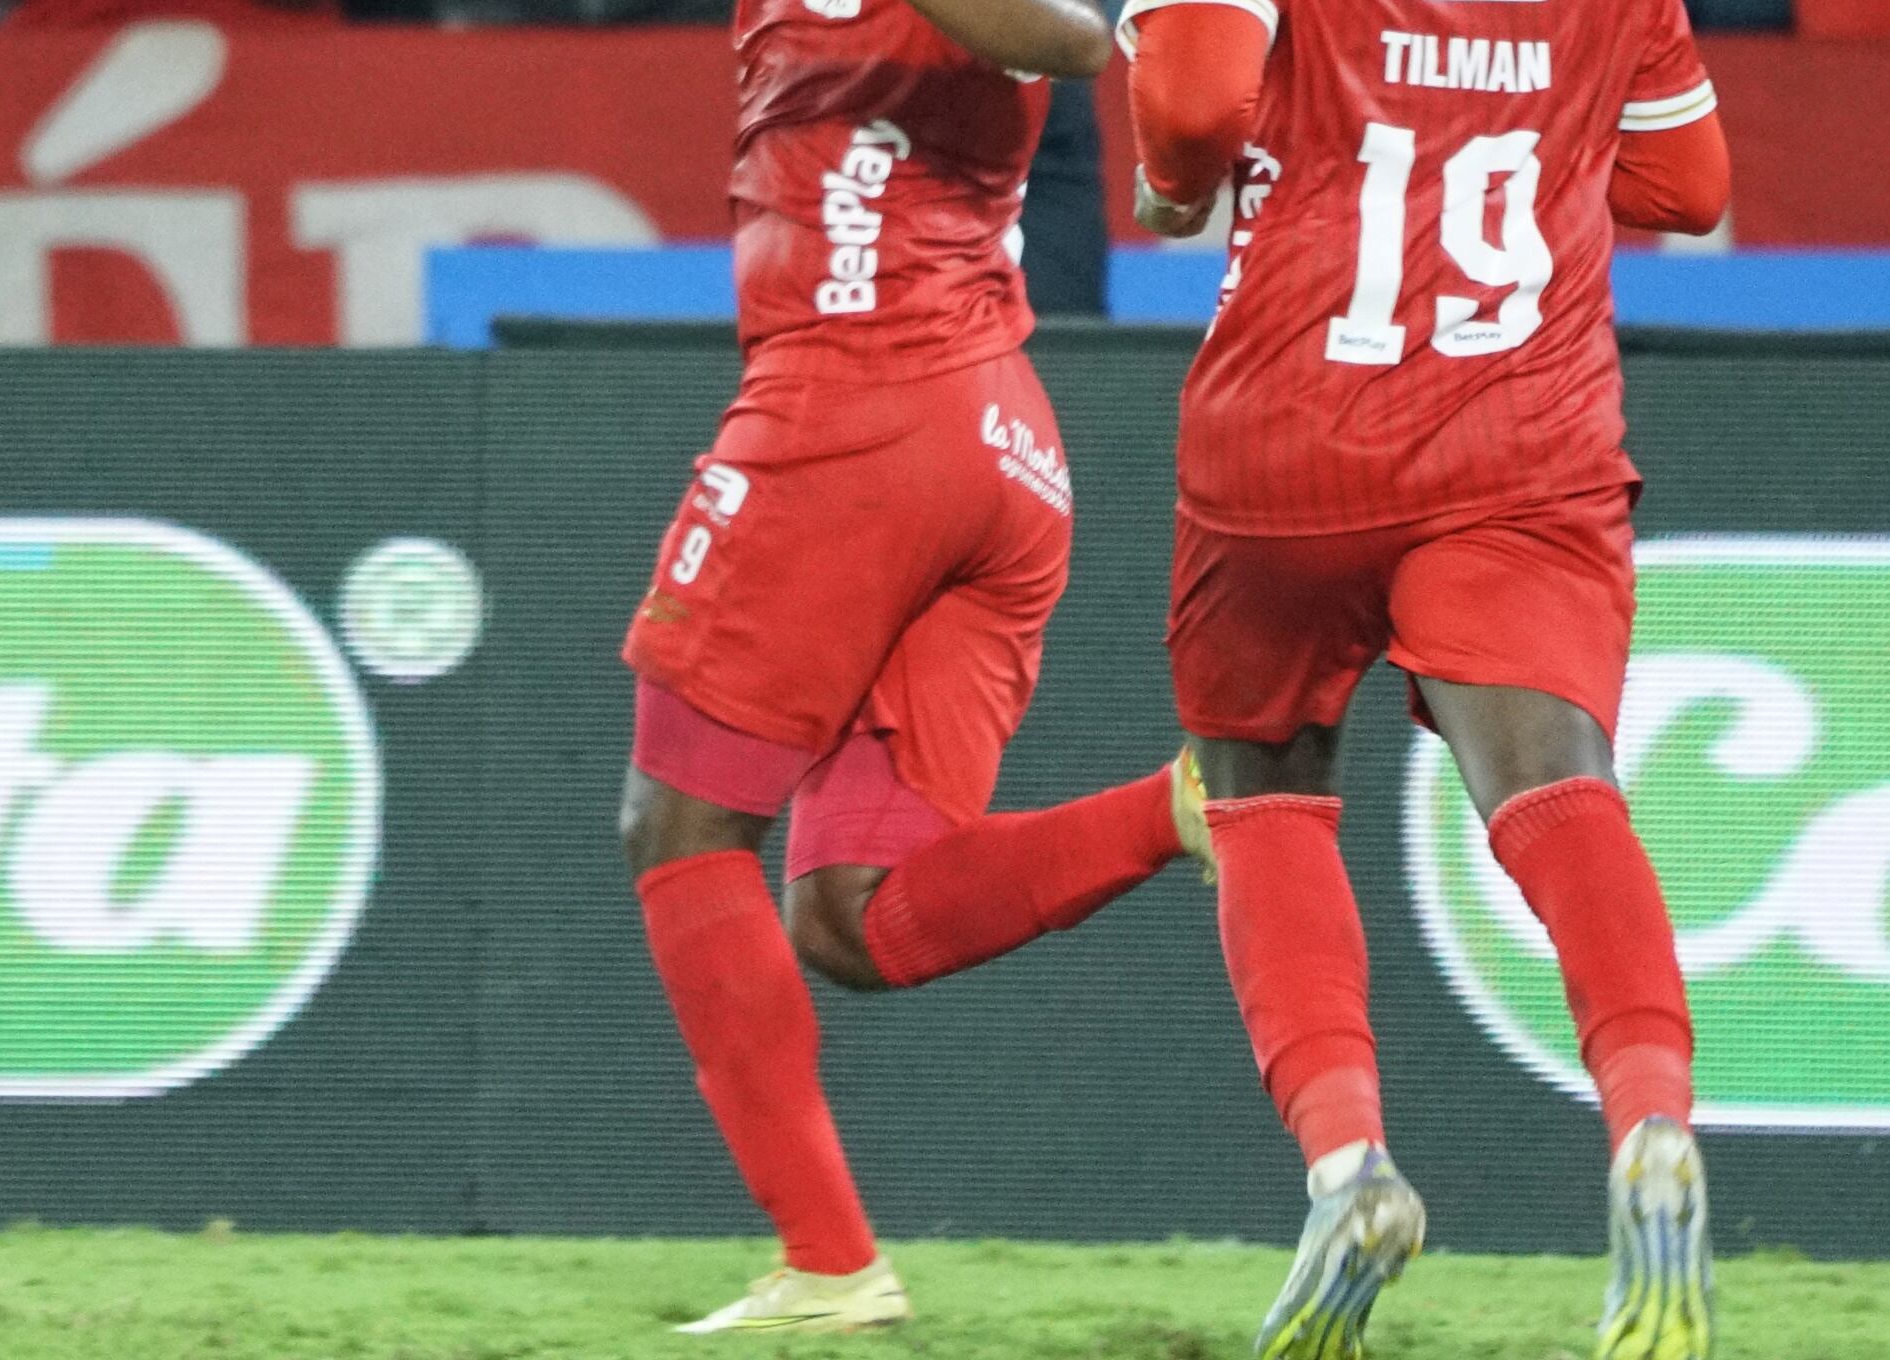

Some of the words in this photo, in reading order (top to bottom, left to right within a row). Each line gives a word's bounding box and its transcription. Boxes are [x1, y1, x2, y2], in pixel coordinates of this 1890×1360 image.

[1380, 29, 1552, 94] TILMAN
[815, 119, 911, 314] BetPlay
[1324, 122, 1554, 365] 19
[671, 524, 712, 585] 9
